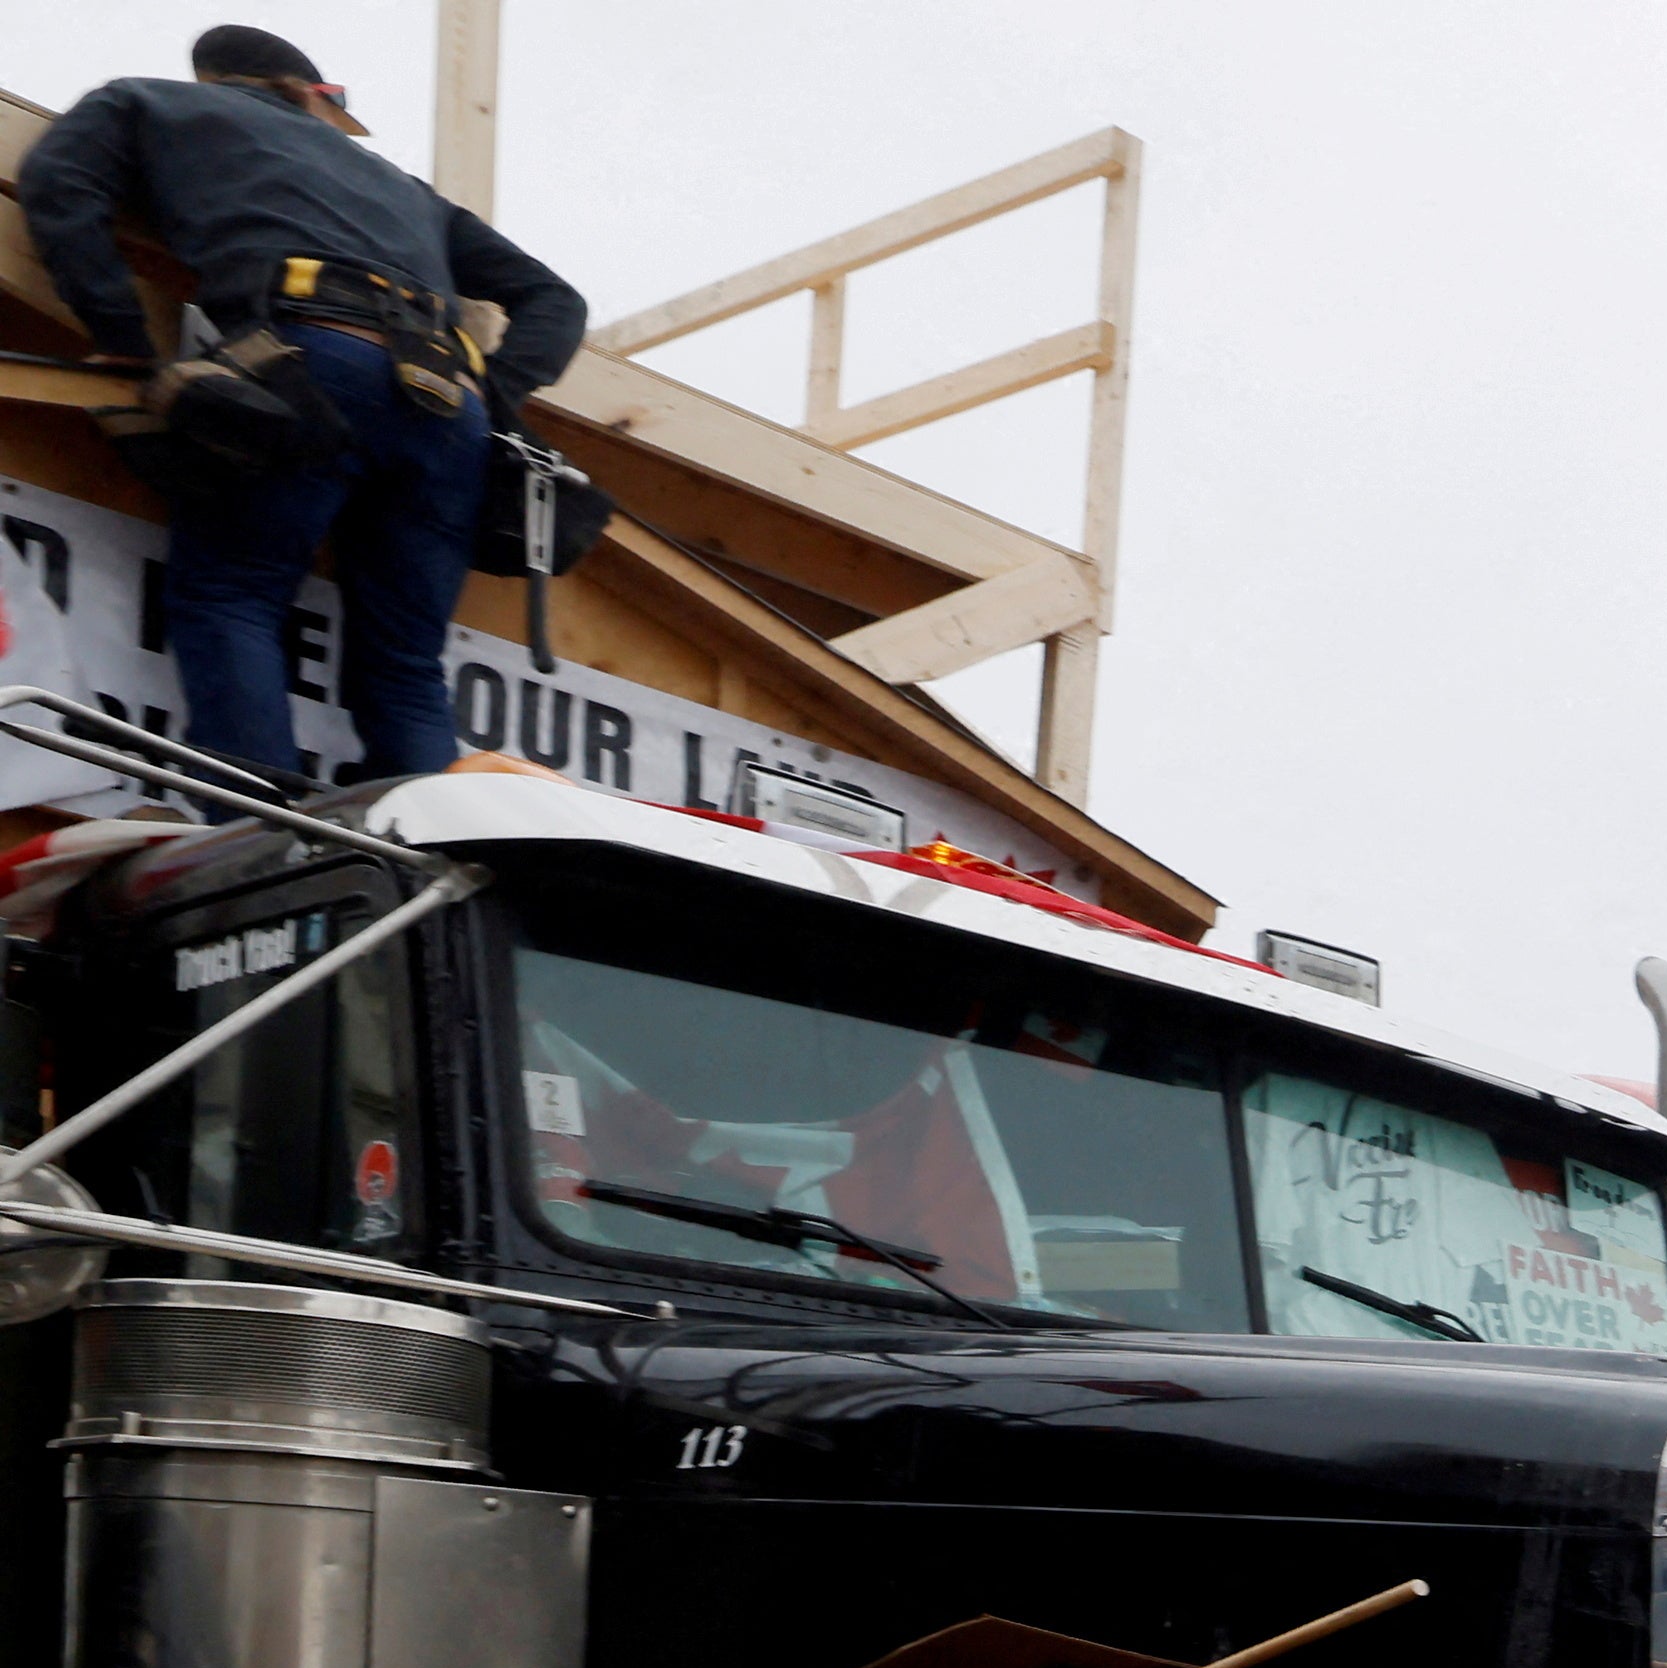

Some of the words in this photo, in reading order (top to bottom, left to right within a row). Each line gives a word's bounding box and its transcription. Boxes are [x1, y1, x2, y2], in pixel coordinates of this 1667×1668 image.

[1509, 1244, 1622, 1300] FAITH
[1524, 1290, 1620, 1340] OVER
[676, 1425, 747, 1471] 113
